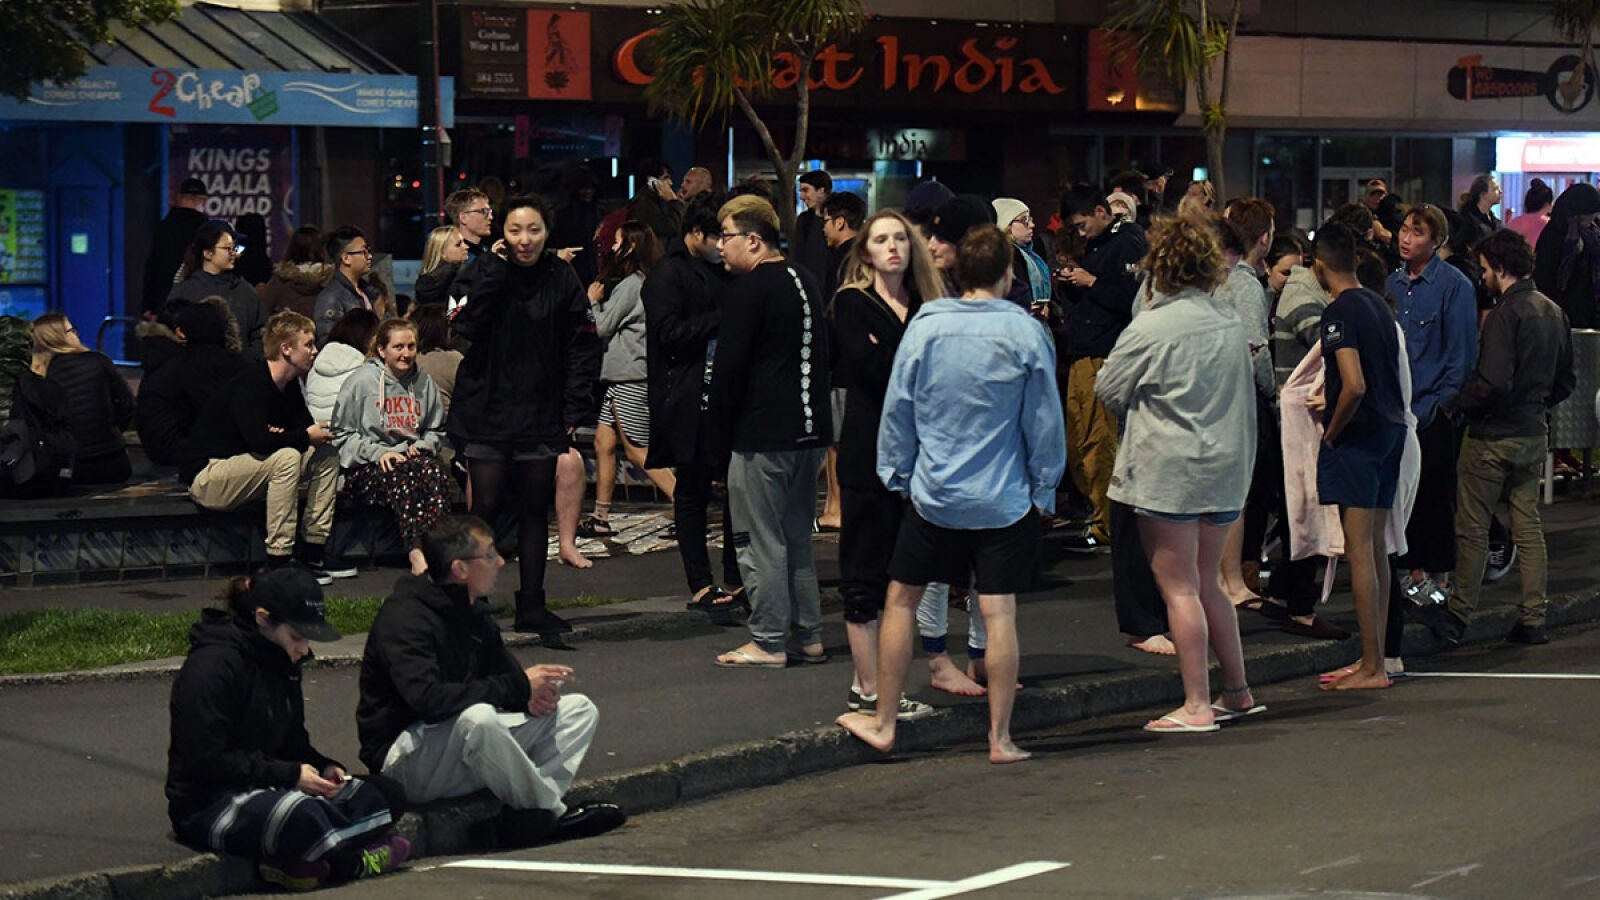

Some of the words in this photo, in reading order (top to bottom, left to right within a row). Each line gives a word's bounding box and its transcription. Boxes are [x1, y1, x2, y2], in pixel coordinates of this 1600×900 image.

[611, 28, 864, 92] Gat
[876, 35, 1064, 95] India
[148, 68, 176, 118] 2
[175, 71, 261, 109] Cheap
[878, 132, 929, 158] India
[188, 147, 271, 172] KINGS
[204, 195, 272, 216] OMAD
[375, 396, 422, 417] OKYO
